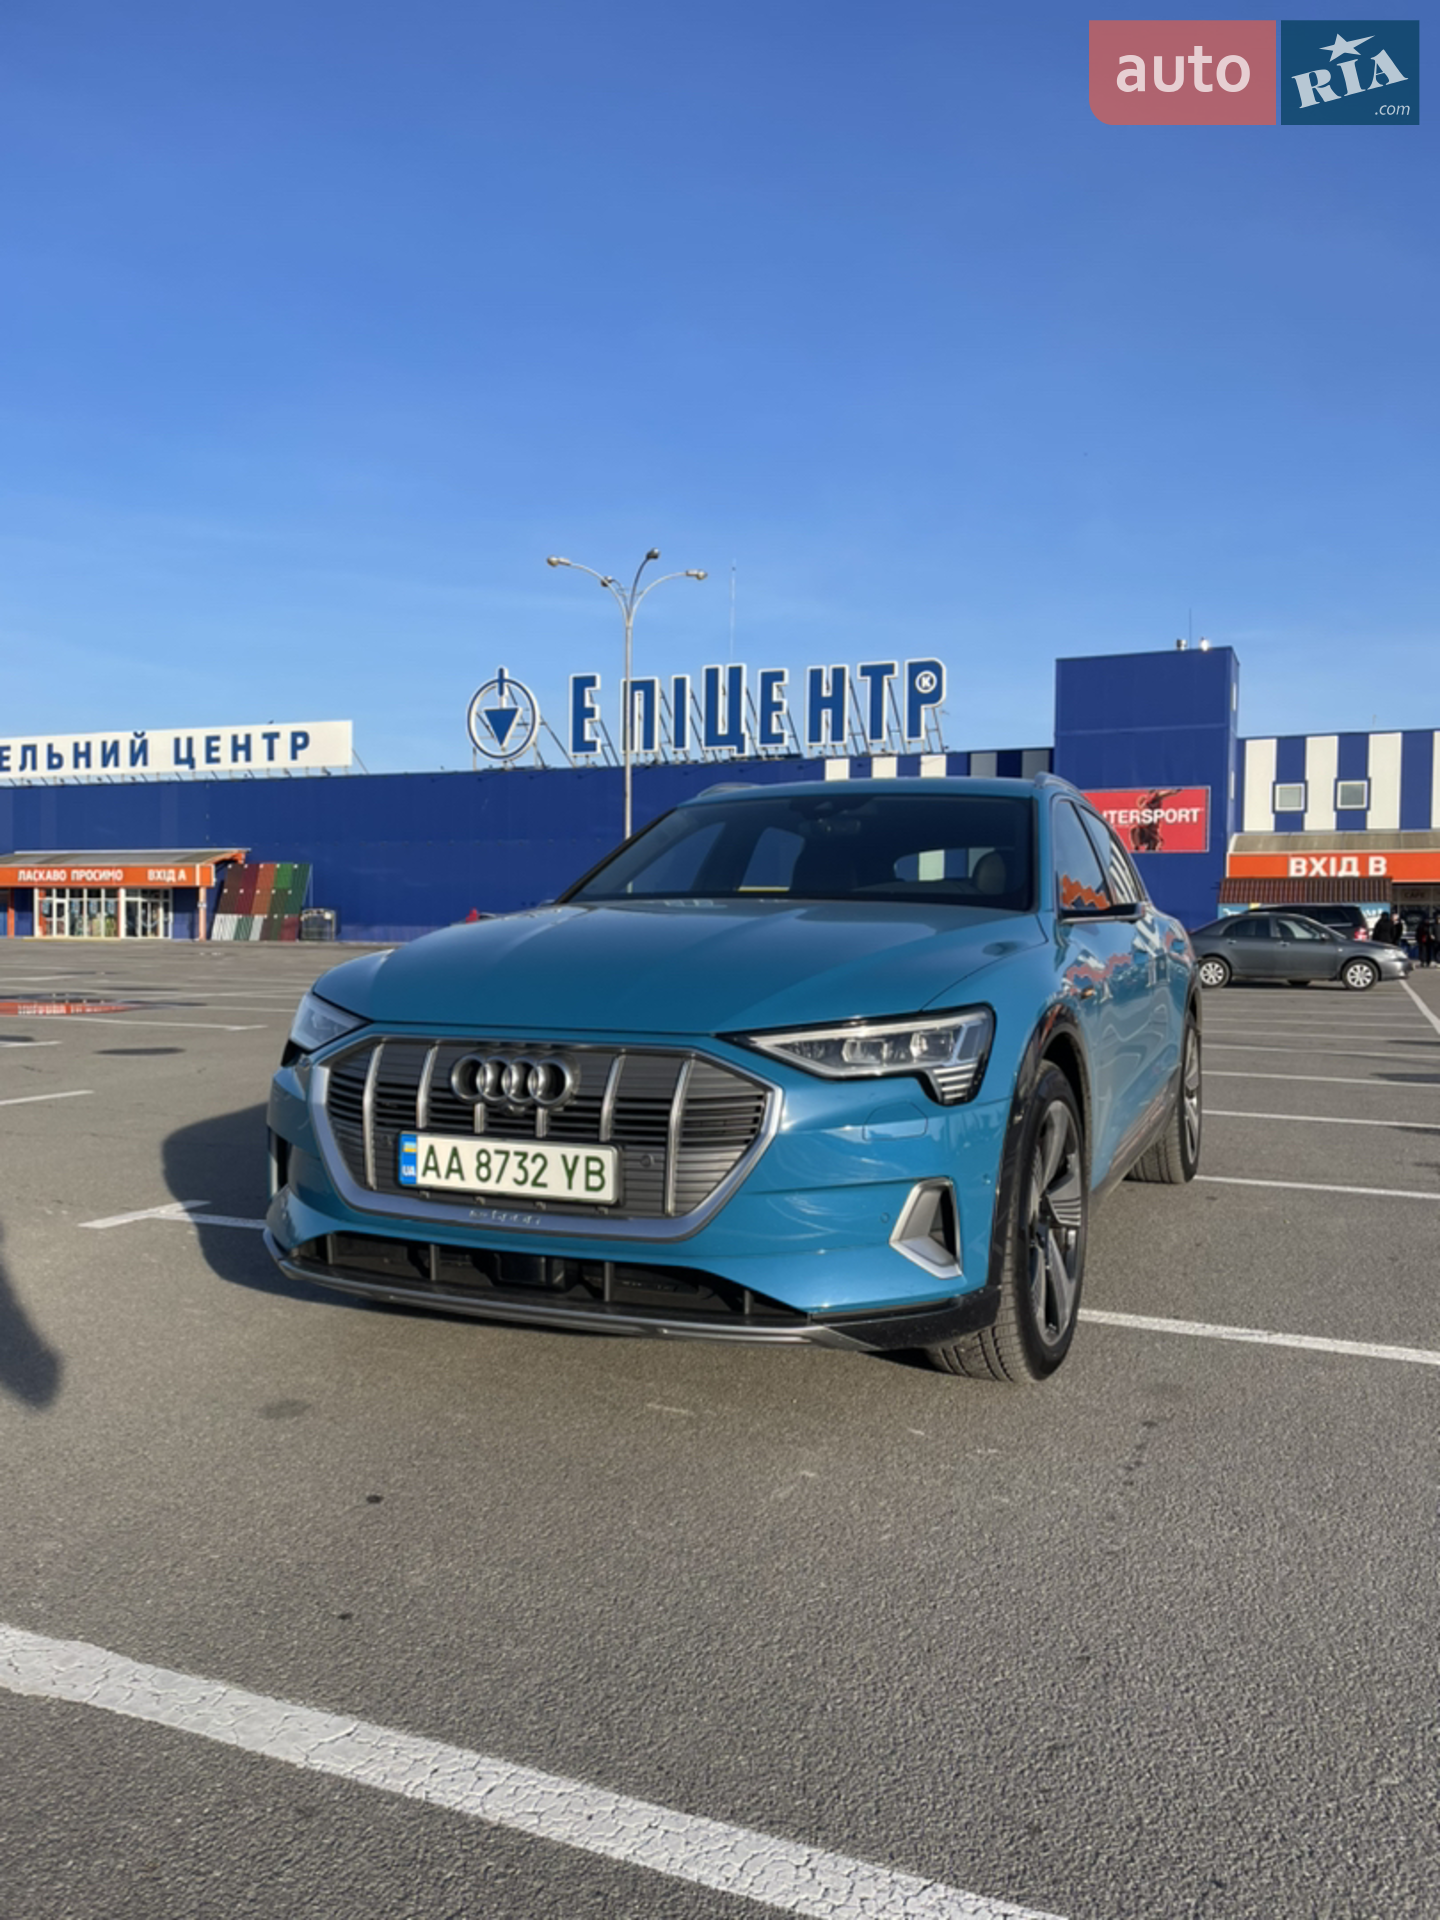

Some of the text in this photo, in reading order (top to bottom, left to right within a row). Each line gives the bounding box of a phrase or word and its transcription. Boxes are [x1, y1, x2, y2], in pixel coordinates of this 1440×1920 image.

[569, 658, 946, 756] ЕПІЦЕНТР
[0, 731, 310, 772] ЕЛЬНИЙ ЦЕНТР
[18, 868, 124, 882] ЛАСКАВО ПРОСИМО
[147, 869, 187, 882] ВХІД А
[1290, 856, 1387, 877] ВХІД В
[421, 1144, 606, 1192] AA 8732 YB
